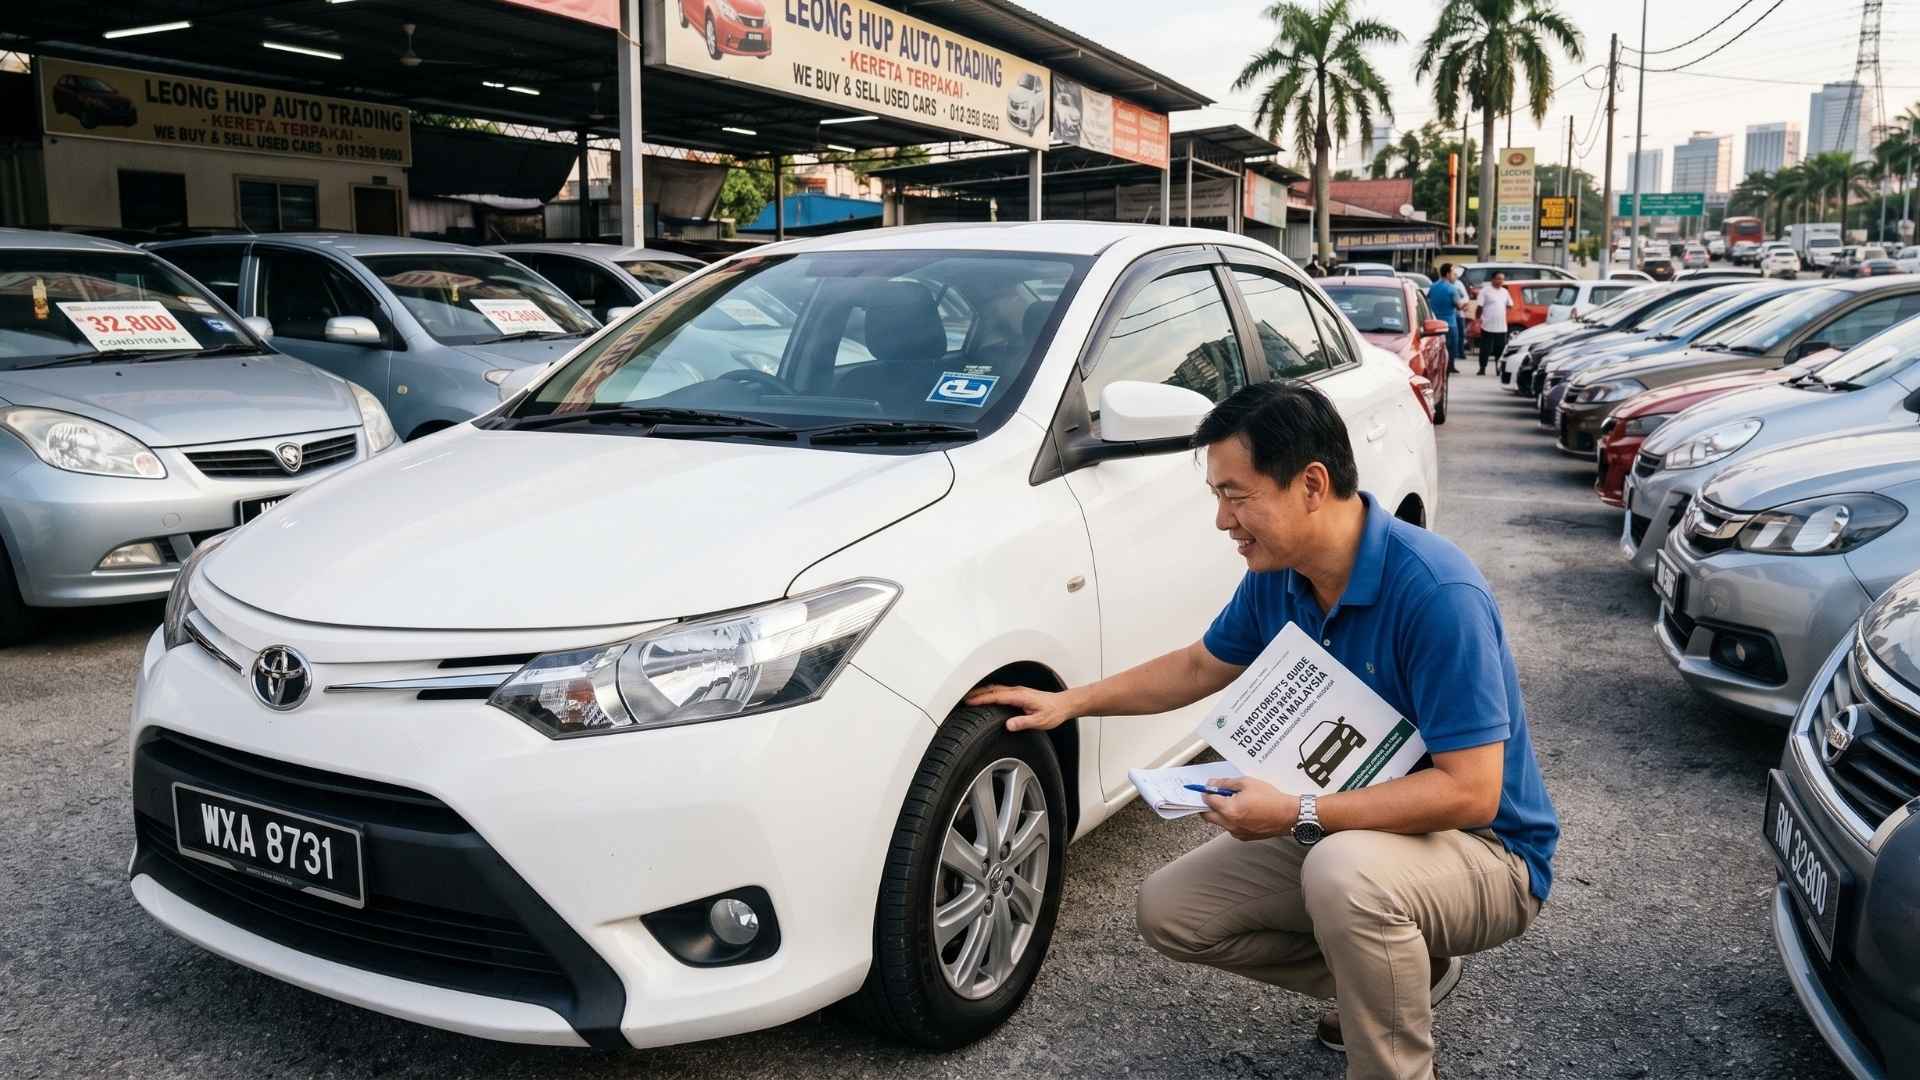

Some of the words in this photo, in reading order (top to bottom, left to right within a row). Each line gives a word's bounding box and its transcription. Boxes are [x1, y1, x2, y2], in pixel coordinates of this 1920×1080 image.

[784, 0, 852, 41] LEONG
[858, 9, 894, 52] HUP
[899, 25, 941, 68] AUTO
[945, 40, 1003, 88] TRADING
[793, 62, 812, 87] WE
[816, 69, 840, 96] BUY
[843, 76, 852, 97] &
[856, 79, 880, 104] SELL
[884, 86, 909, 111] USED
[913, 93, 937, 116] CARS
[850, 51, 903, 83] KERETA
[907, 67, 964, 99] TERPAKAI
[144, 79, 219, 110] LEONG
[225, 90, 267, 116] HUP
[272, 96, 322, 122] AUTO
[328, 104, 403, 132] TRADING
[212, 114, 277, 134] KERETA
[280, 121, 354, 141] TERPAKAI
[153, 124, 176, 140] WE
[179, 126, 207, 144] BUY
[224, 131, 253, 148] SELL
[257, 136, 289, 152] USED
[292, 140, 322, 154] CARS
[87, 315, 177, 335] 32,800
[100, 336, 167, 347] CONDITION
[1230, 724, 1248, 742] THE
[1245, 680, 1288, 727] MOTORIST'S
[1247, 724, 1280, 758] BUYING
[1277, 713, 1290, 726] IN
[1286, 671, 1328, 715] MALAYSIA
[1238, 735, 1253, 749] TO
[201, 803, 257, 857] WXA
[265, 822, 333, 880] 8731
[1775, 801, 1793, 860] RM
[1791, 829, 1827, 916] 32800
